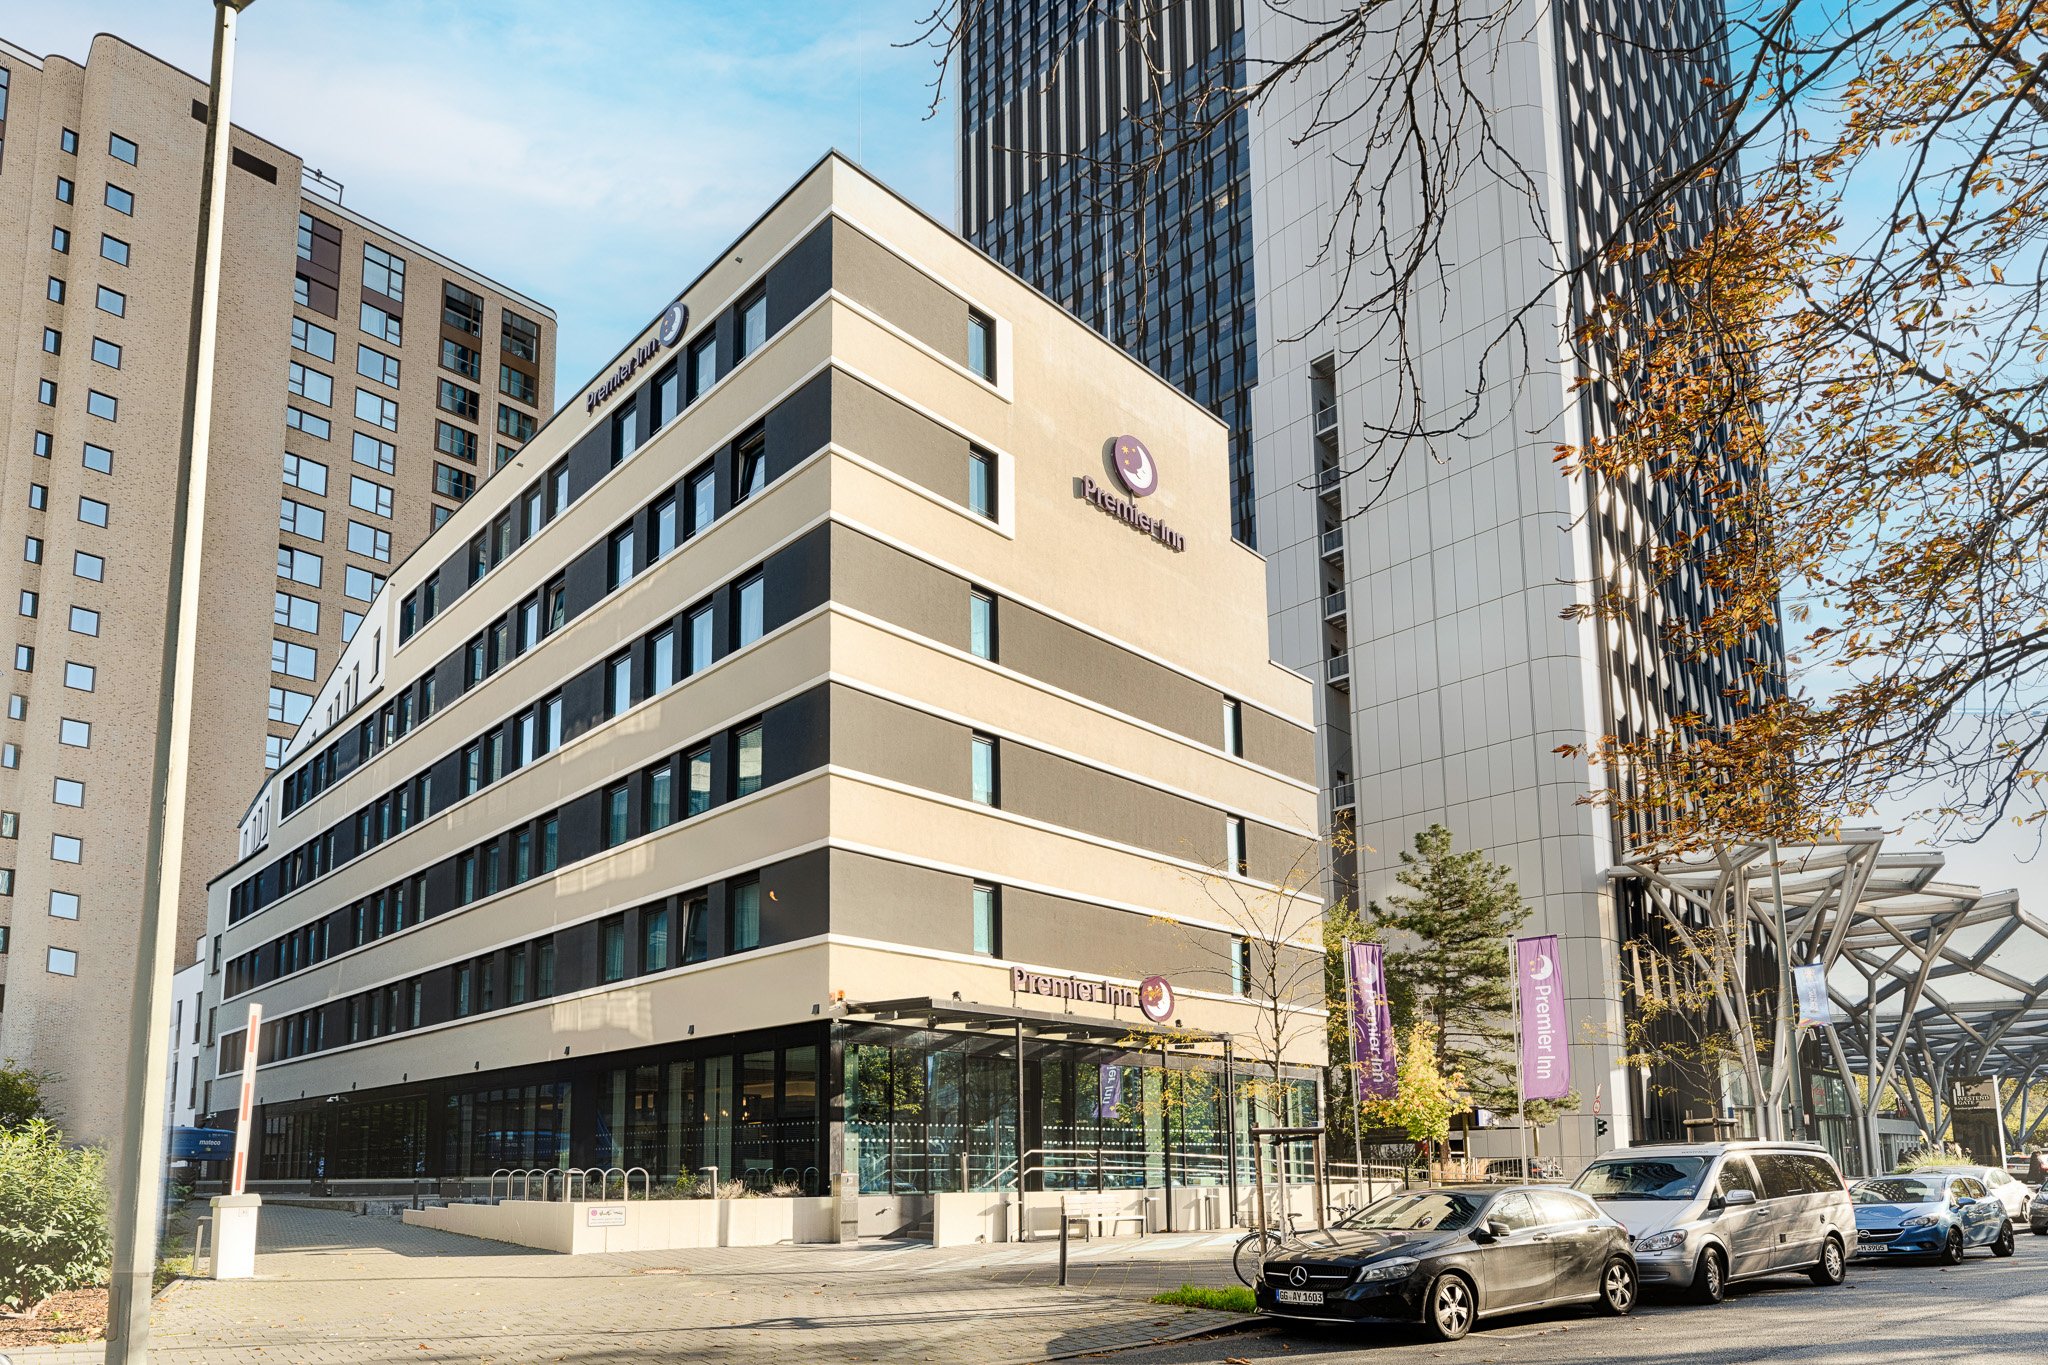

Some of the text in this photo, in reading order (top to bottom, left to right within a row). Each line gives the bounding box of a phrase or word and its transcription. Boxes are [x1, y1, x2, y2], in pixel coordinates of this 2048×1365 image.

[586, 337, 660, 412] Premier Inn
[1082, 475, 1186, 552] Premier Inn
[1010, 966, 1135, 1007] Premier Inn
[1365, 990, 1384, 1083] Premier Inn
[1535, 985, 1556, 1079] Premier Inn
[1280, 1291, 1323, 1302] GG AY 1603
